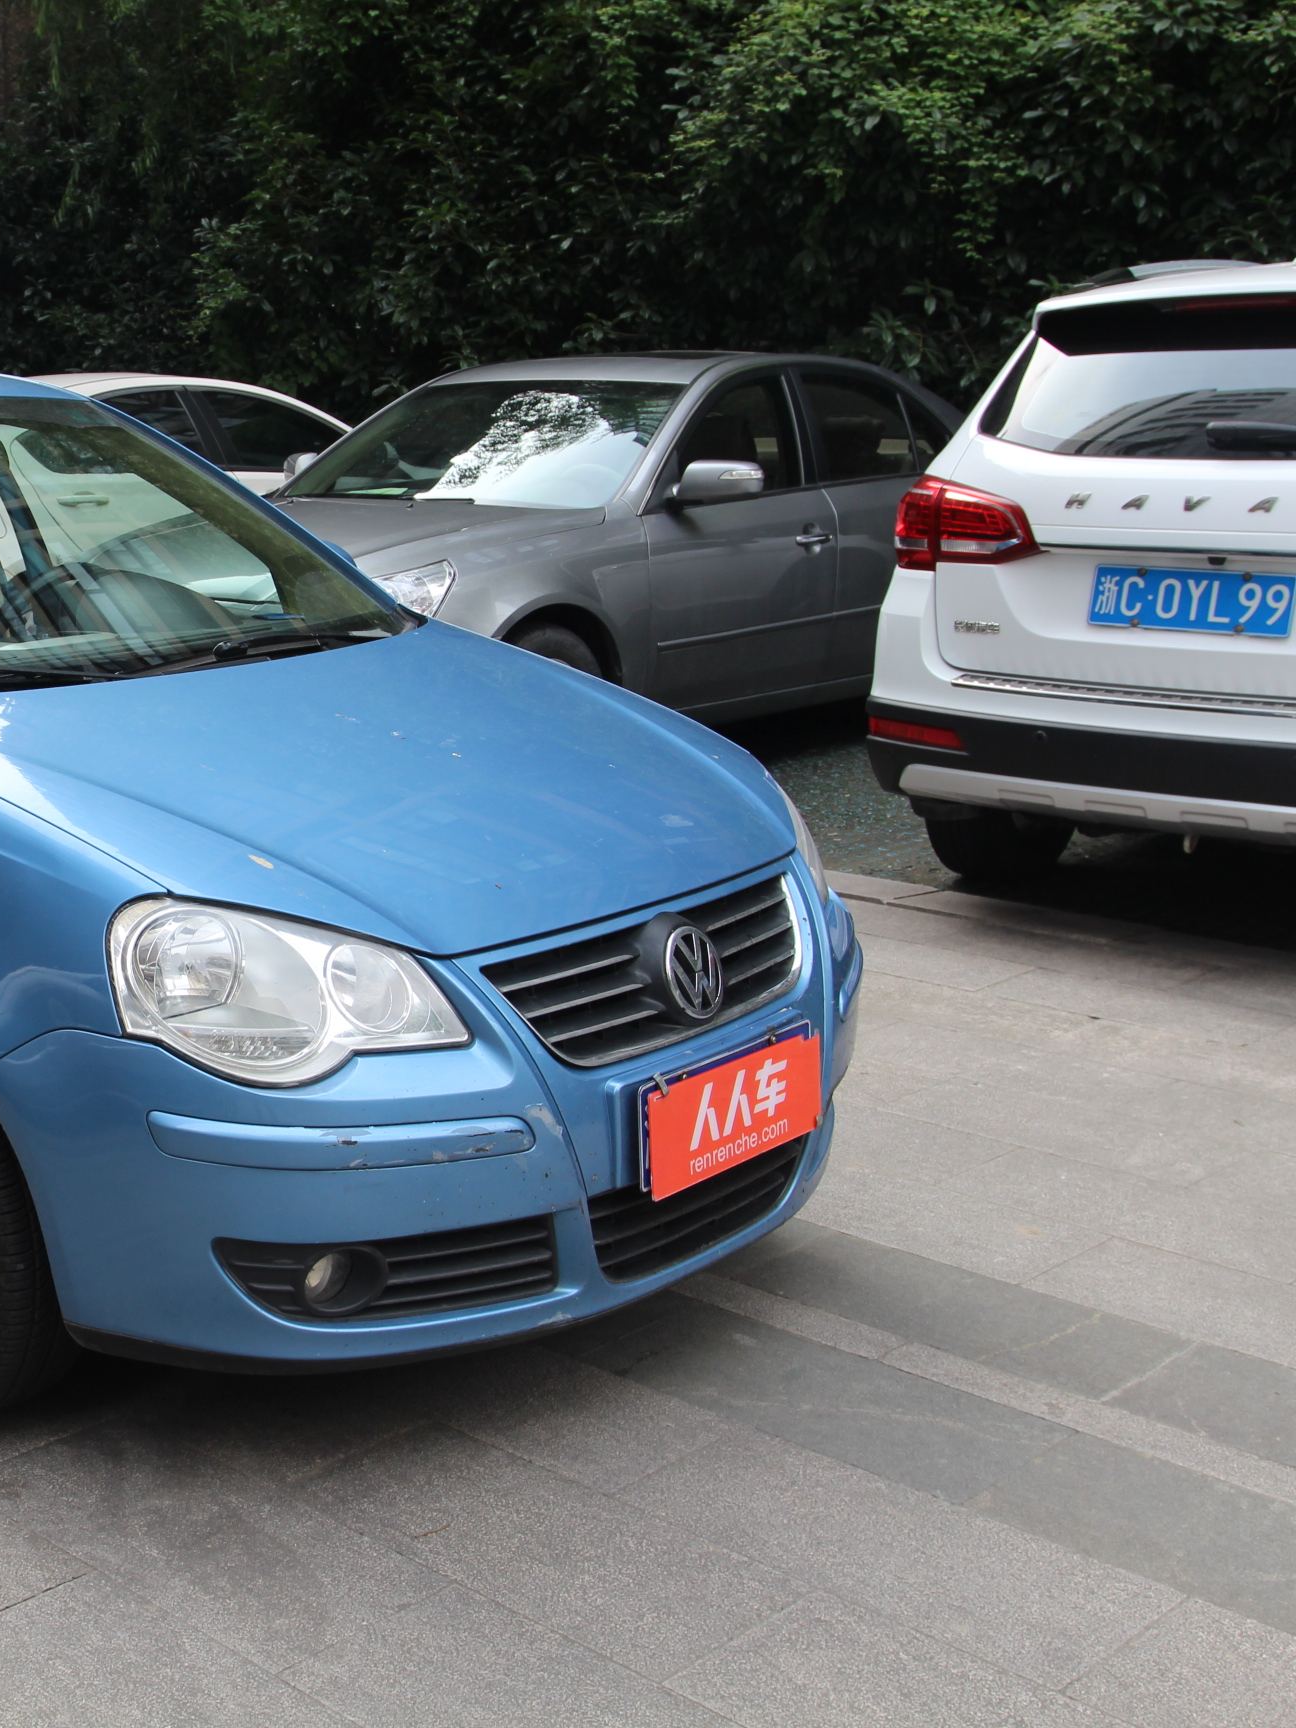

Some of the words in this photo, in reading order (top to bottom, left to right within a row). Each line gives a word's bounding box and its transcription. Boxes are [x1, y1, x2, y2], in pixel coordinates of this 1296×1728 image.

[689, 1058, 788, 1152] 人人车
[689, 1118, 788, 1175] renrenche.com
